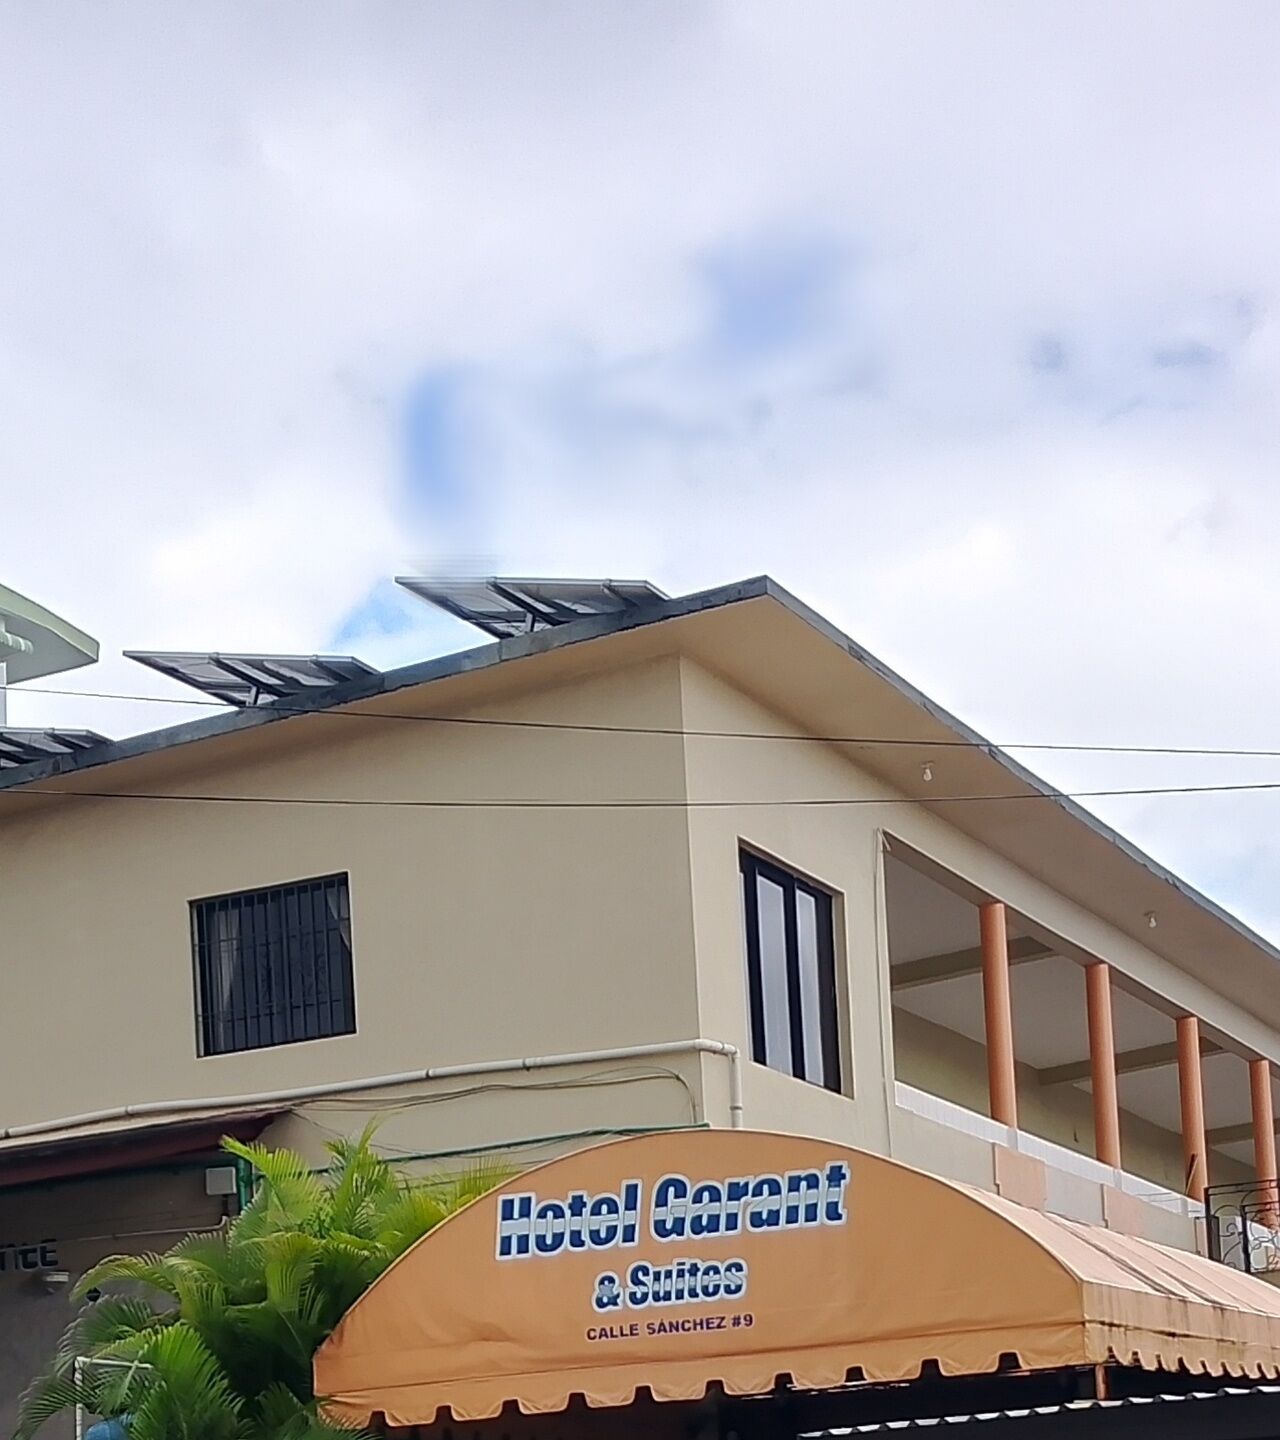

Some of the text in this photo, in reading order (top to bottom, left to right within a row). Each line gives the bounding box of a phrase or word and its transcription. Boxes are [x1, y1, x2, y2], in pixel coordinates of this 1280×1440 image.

[495, 1160, 851, 1261] Hotel Garant
[593, 1258, 747, 1311] & Suites
[586, 1313, 754, 1341] CALLE SÁNCHEZ #9
